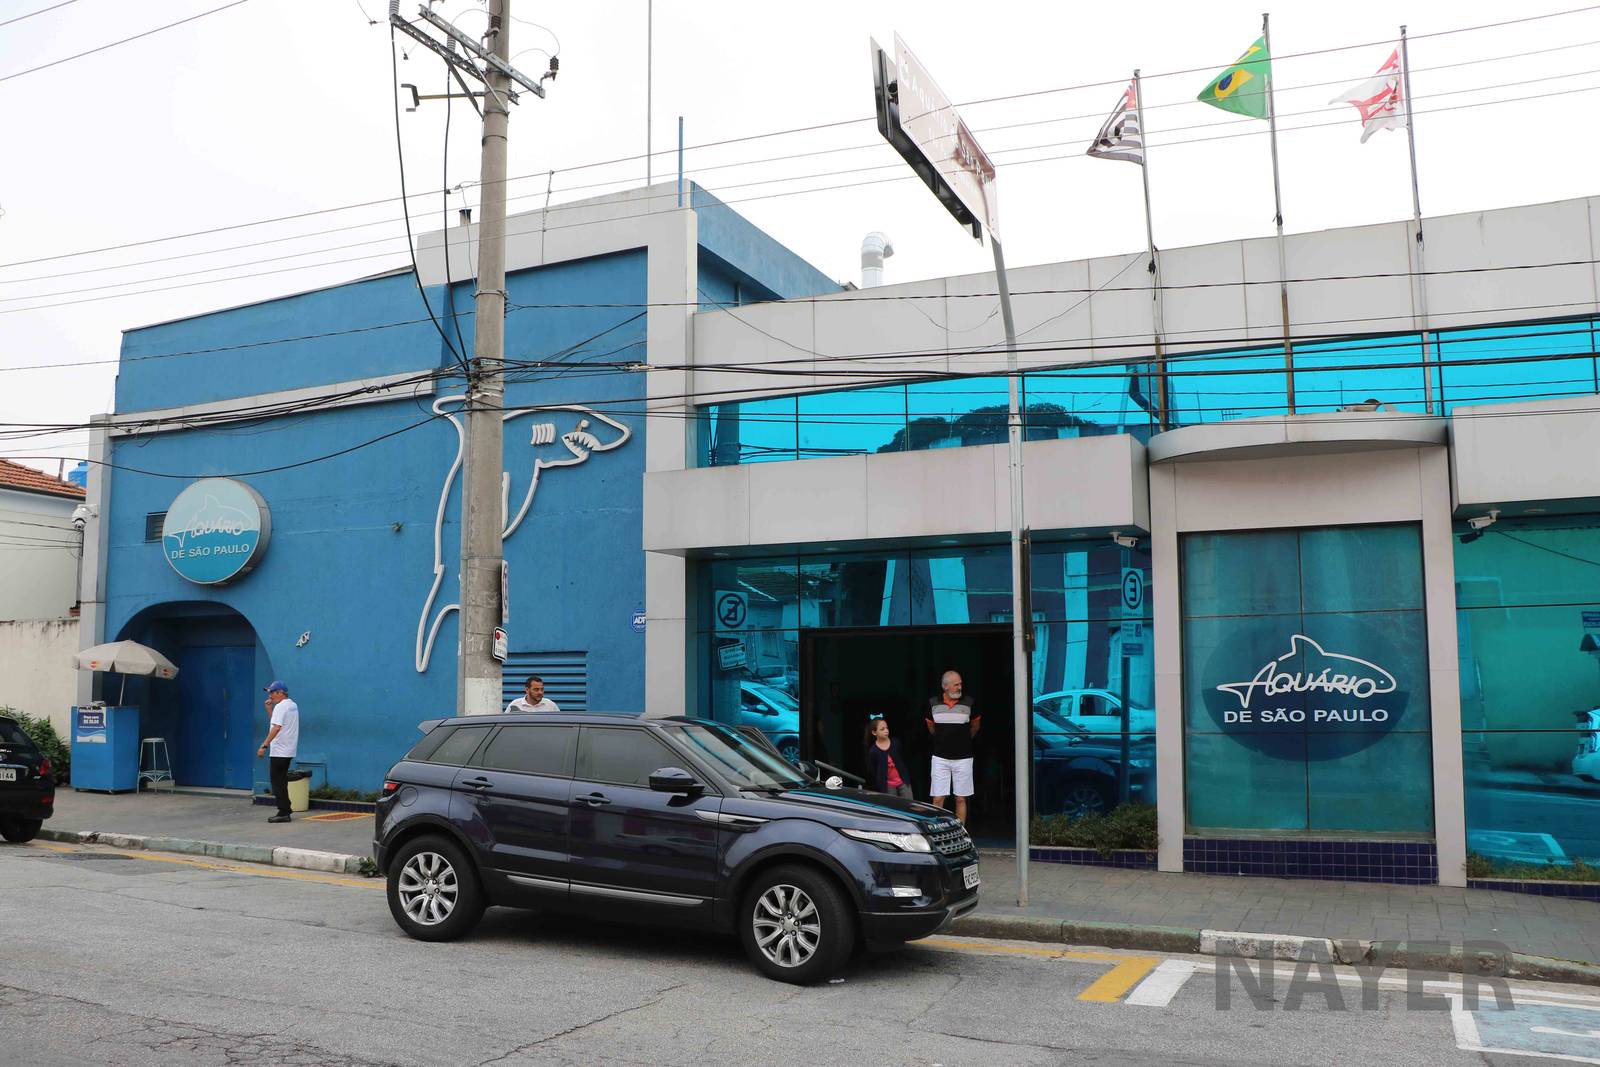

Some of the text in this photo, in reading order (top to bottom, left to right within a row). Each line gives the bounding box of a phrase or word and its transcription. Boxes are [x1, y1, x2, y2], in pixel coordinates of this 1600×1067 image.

[171, 544, 250, 559] DE SÃO PAULO
[1235, 659, 1378, 708] AQUÁRIO
[1223, 707, 1389, 723] DE SÃO PAULO
